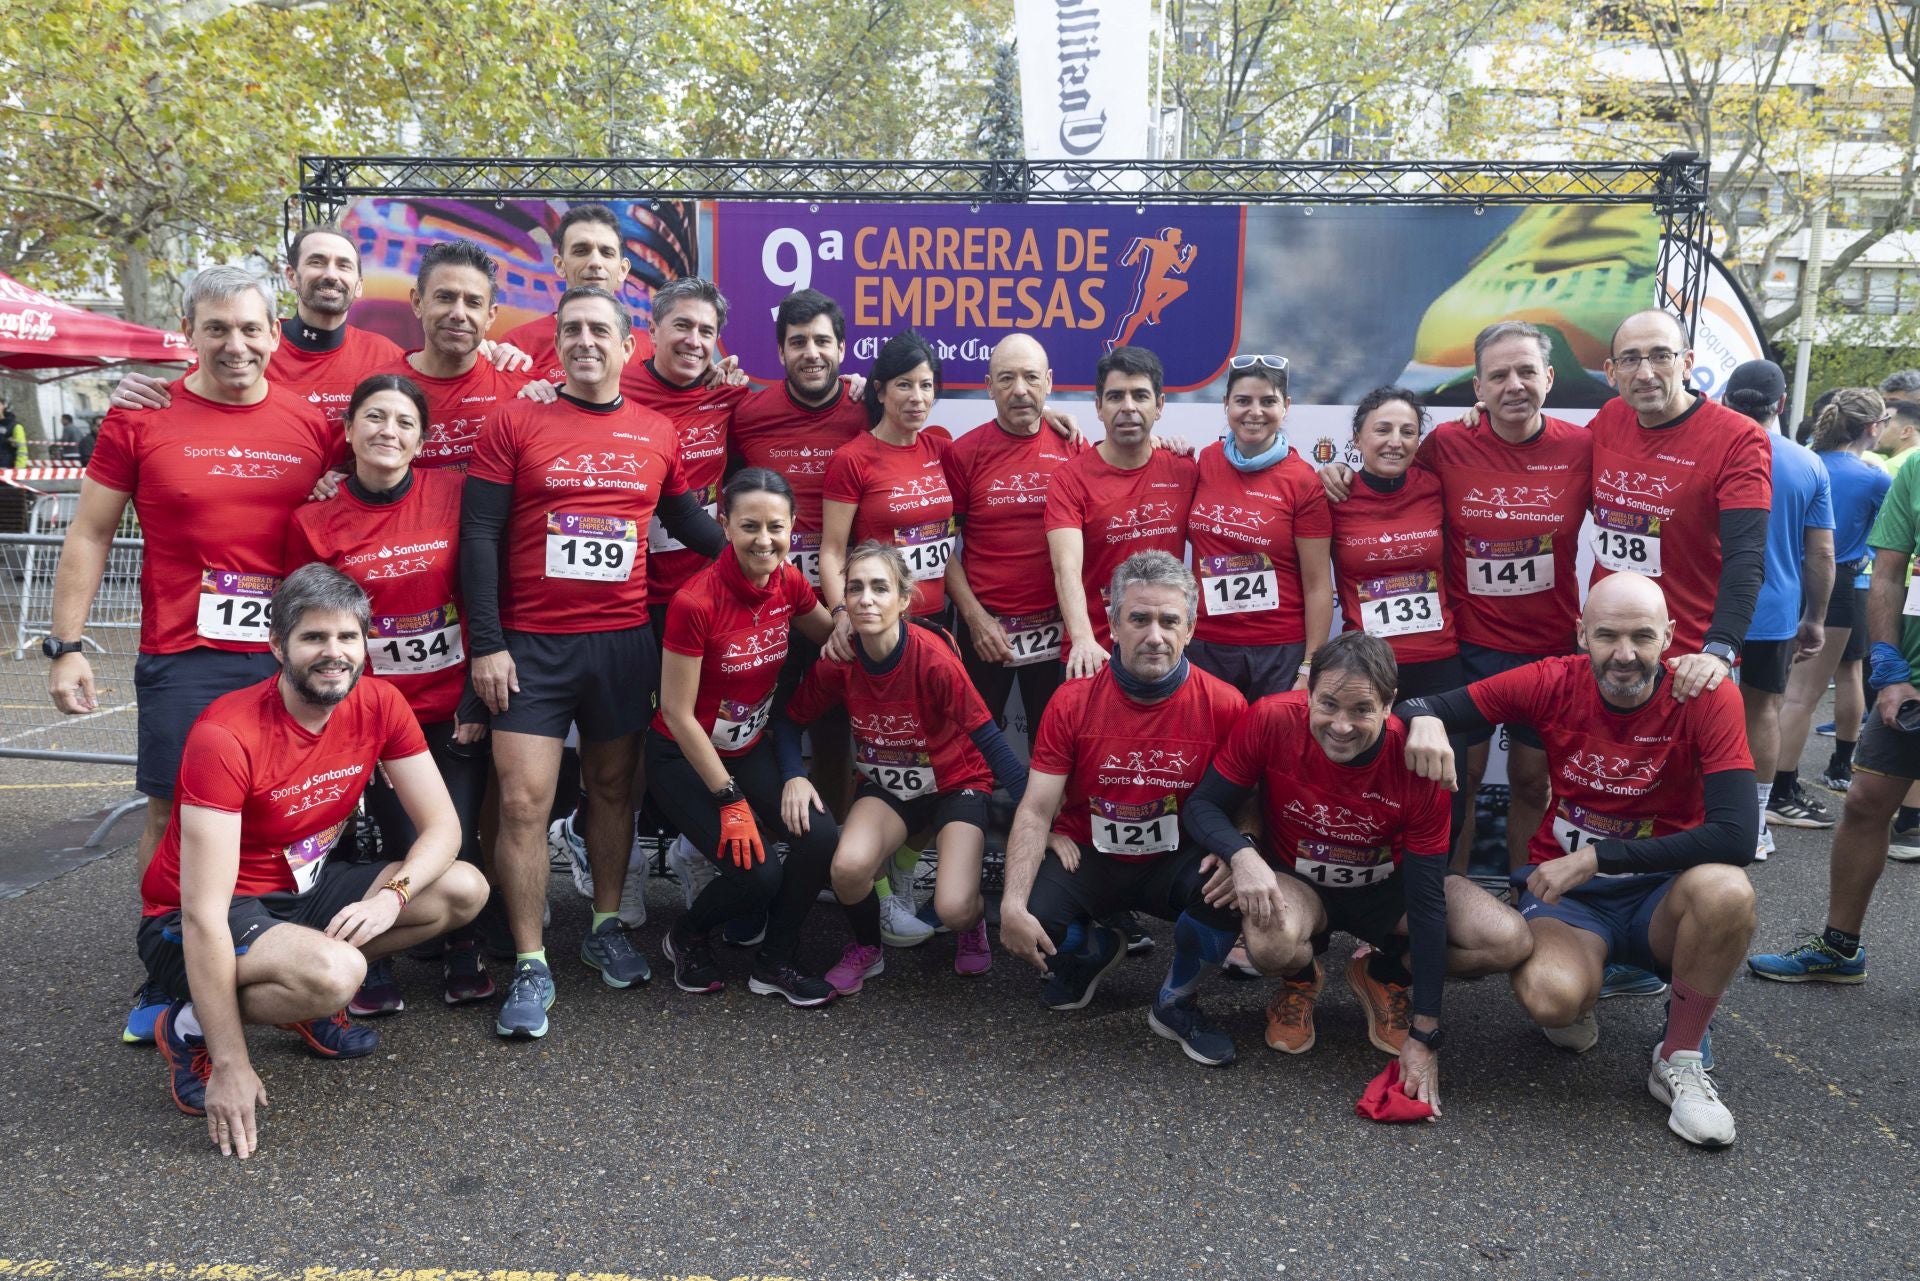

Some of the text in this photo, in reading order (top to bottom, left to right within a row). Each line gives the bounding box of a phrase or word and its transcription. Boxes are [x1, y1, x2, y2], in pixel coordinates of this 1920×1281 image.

[854, 226, 1043, 271] CARRERA
[1056, 228, 1109, 272] DE
[855, 276, 1106, 329] EMPRESAS
[936, 338, 958, 361] de
[184, 446, 303, 464] Sports Santander
[453, 445, 473, 454] San
[686, 446, 724, 460] Santander
[769, 449, 799, 459] Sports
[545, 476, 648, 491] Sports Santander
[889, 501, 919, 513] Sports
[987, 496, 1015, 507] Sports
[1595, 487, 1675, 516] Sports Santander
[1461, 506, 1564, 523] Sports Santander
[1106, 532, 1132, 544] Sports
[1188, 519, 1272, 546] Sports Santander
[1346, 529, 1439, 547] Sports Santander
[344, 539, 448, 565] Sports Santander
[561, 539, 624, 569] 139
[910, 541, 950, 570] 130
[1599, 531, 1647, 563] 138
[237, 575, 265, 583] CARRERA
[1479, 560, 1536, 584] 141
[237, 581, 273, 591] EMPRESAS
[1214, 574, 1267, 602] 124
[1375, 596, 1431, 624] 133
[383, 632, 450, 663] 134
[1011, 626, 1060, 656] 122
[721, 661, 752, 674] Sports
[270, 763, 364, 801] Sports Santander
[869, 767, 922, 790] 126
[1099, 774, 1194, 789] Sports Santander
[1563, 765, 1588, 786] Sports
[1104, 821, 1162, 845] 121
[1311, 864, 1374, 884] 131
